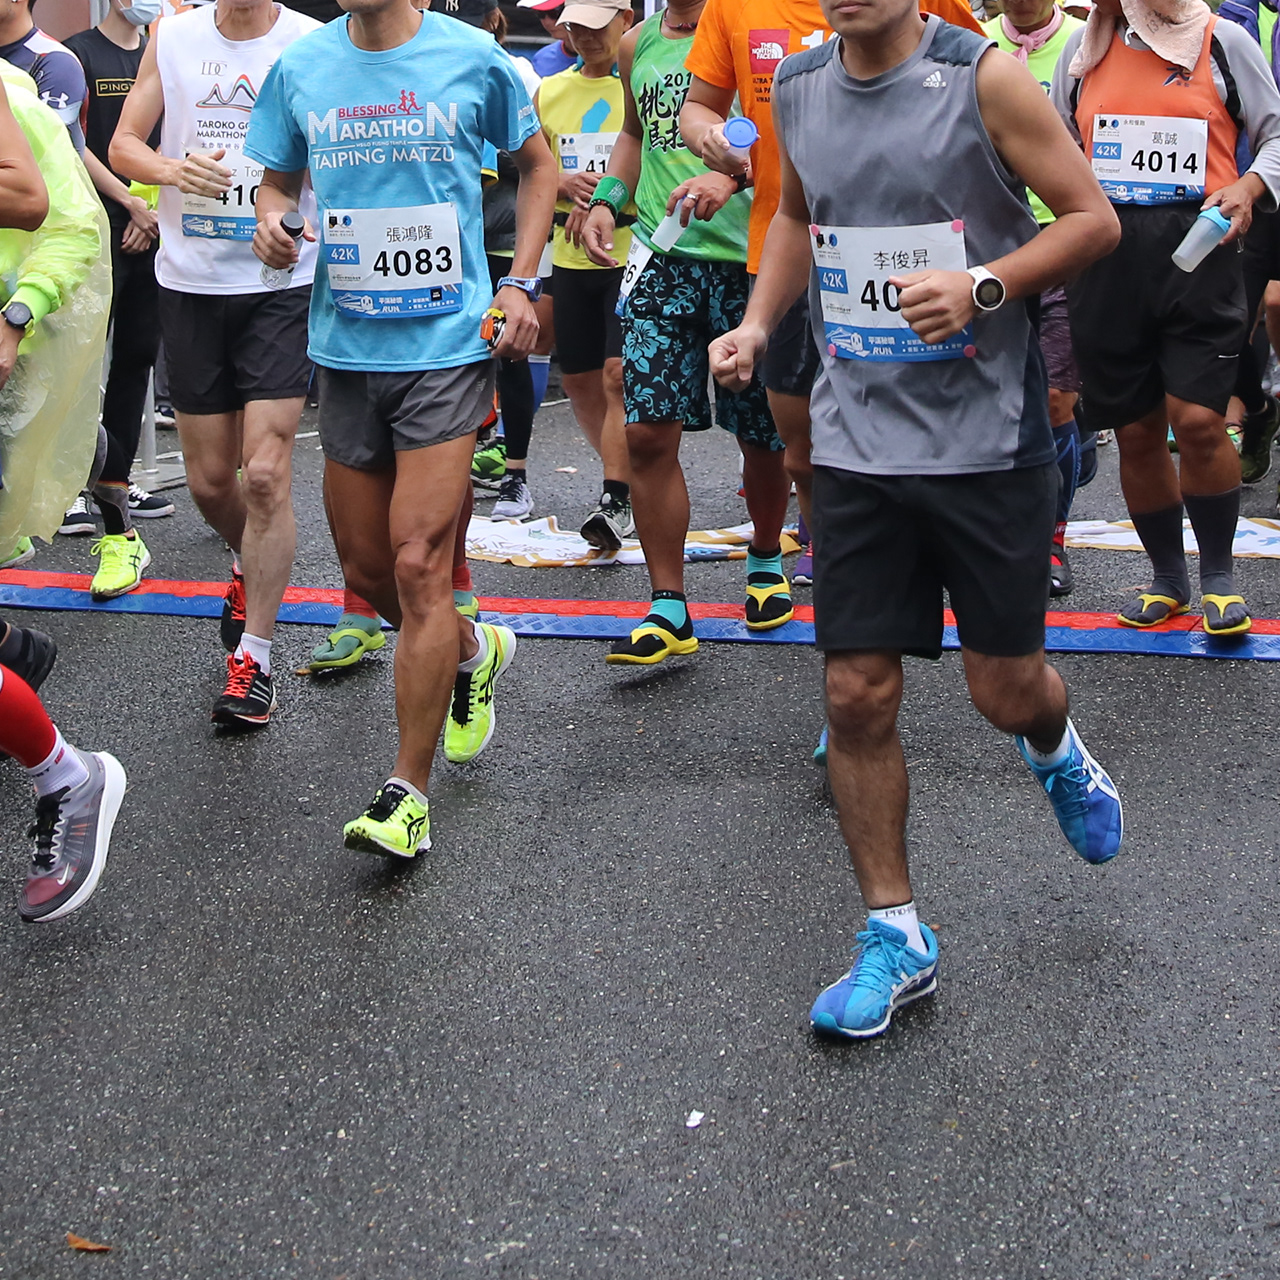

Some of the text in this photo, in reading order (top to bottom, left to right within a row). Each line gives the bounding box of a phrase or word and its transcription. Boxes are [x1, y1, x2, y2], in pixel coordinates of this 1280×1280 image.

[338, 103, 397, 118] BLESSING
[197, 120, 235, 130] TAROKO
[307, 101, 458, 145] MARATHON
[196, 131, 247, 139] MARATHON
[312, 145, 455, 171] TAIPING MATZU
[1096, 145, 1118, 156] 42K
[1131, 149, 1198, 175] 4014
[386, 224, 434, 243] 張鴻隆
[330, 248, 356, 261] 42K
[373, 245, 454, 277] 4083
[873, 248, 931, 270] 李俊昇
[822, 270, 845, 289] 42K
[381, 305, 401, 313] RUN
[872, 346, 894, 355] RUN
